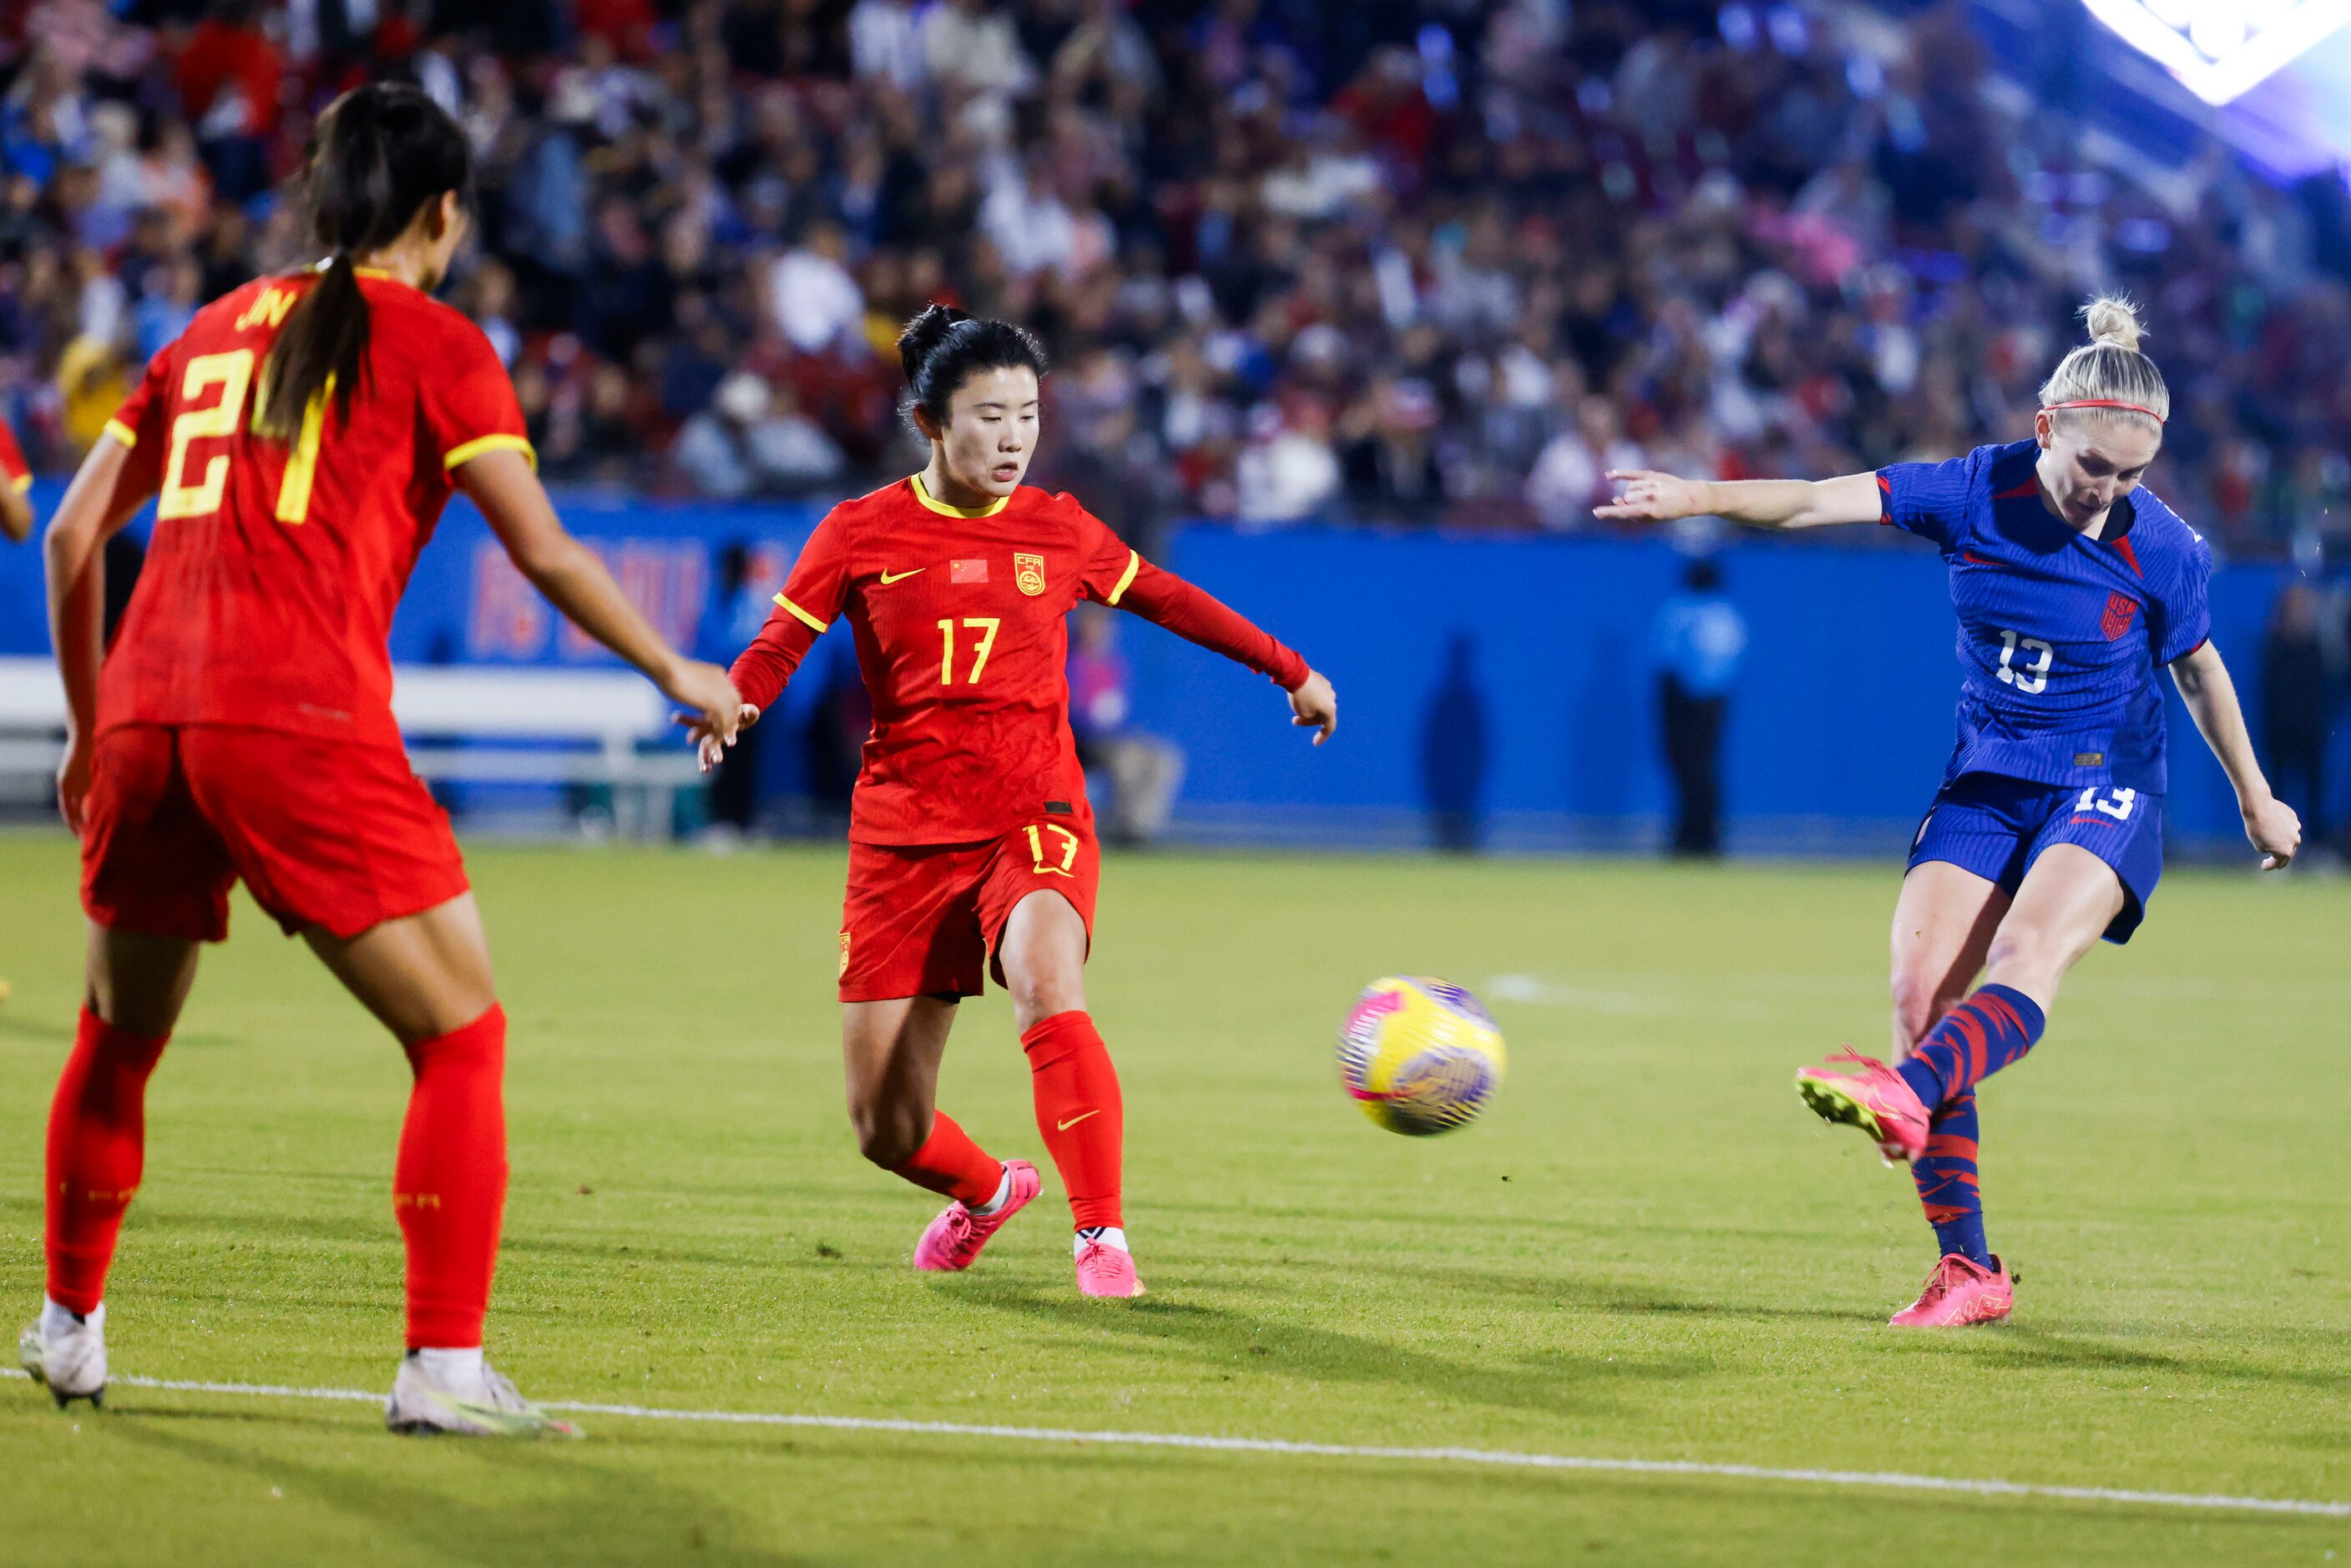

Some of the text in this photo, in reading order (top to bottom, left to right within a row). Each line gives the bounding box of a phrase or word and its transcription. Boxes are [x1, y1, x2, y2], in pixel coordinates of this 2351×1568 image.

[1017, 556, 1041, 567] CFA
[2109, 594, 2137, 615] USA
[938, 618, 1000, 685] 17
[1995, 630, 2054, 695] 13
[2074, 787, 2136, 821] 13
[1022, 823, 1079, 872] 17
